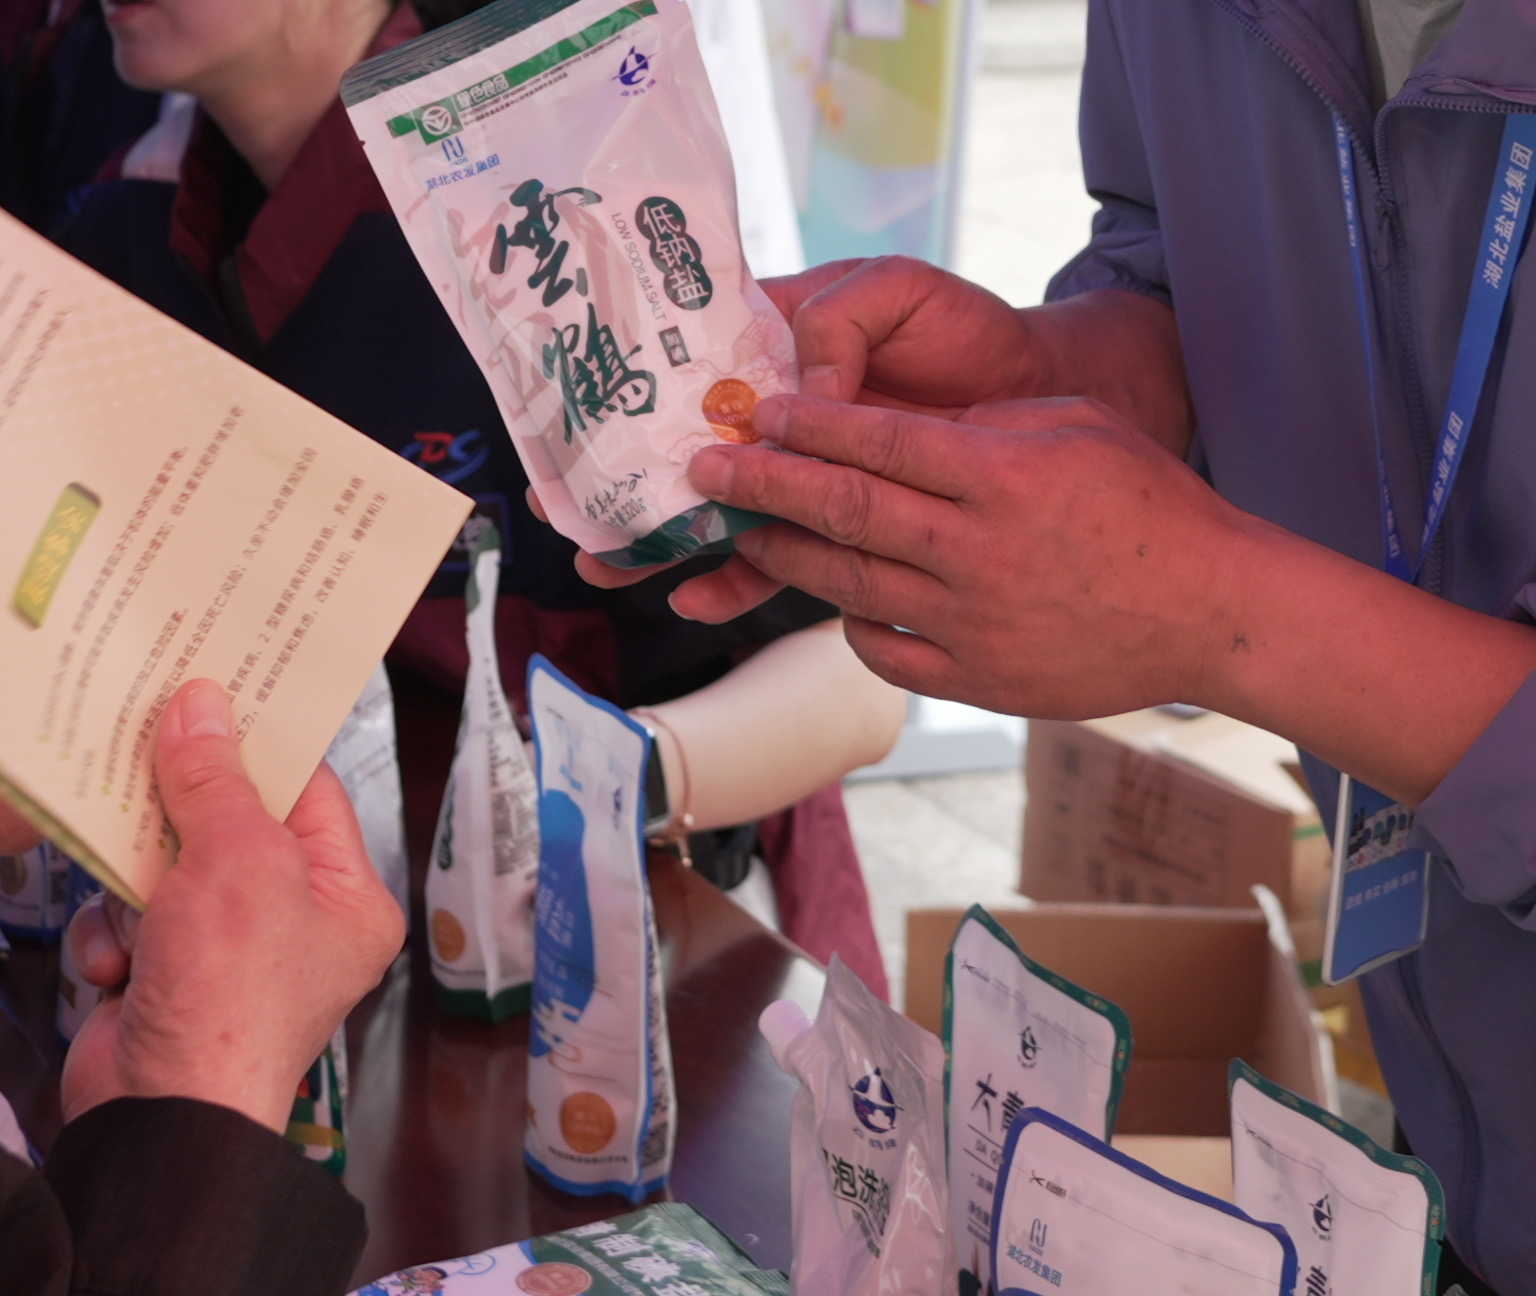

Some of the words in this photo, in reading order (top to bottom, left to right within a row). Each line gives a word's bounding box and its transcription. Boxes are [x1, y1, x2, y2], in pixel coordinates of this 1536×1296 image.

[425, 153, 501, 191] 湖北农发集团
[1482, 142, 1535, 289] 湖北盐业集团
[611, 212, 633, 241] LOW
[624, 240, 654, 293] SODIUM
[646, 289, 668, 322] SALT
[643, 203, 710, 305] 低钠盐
